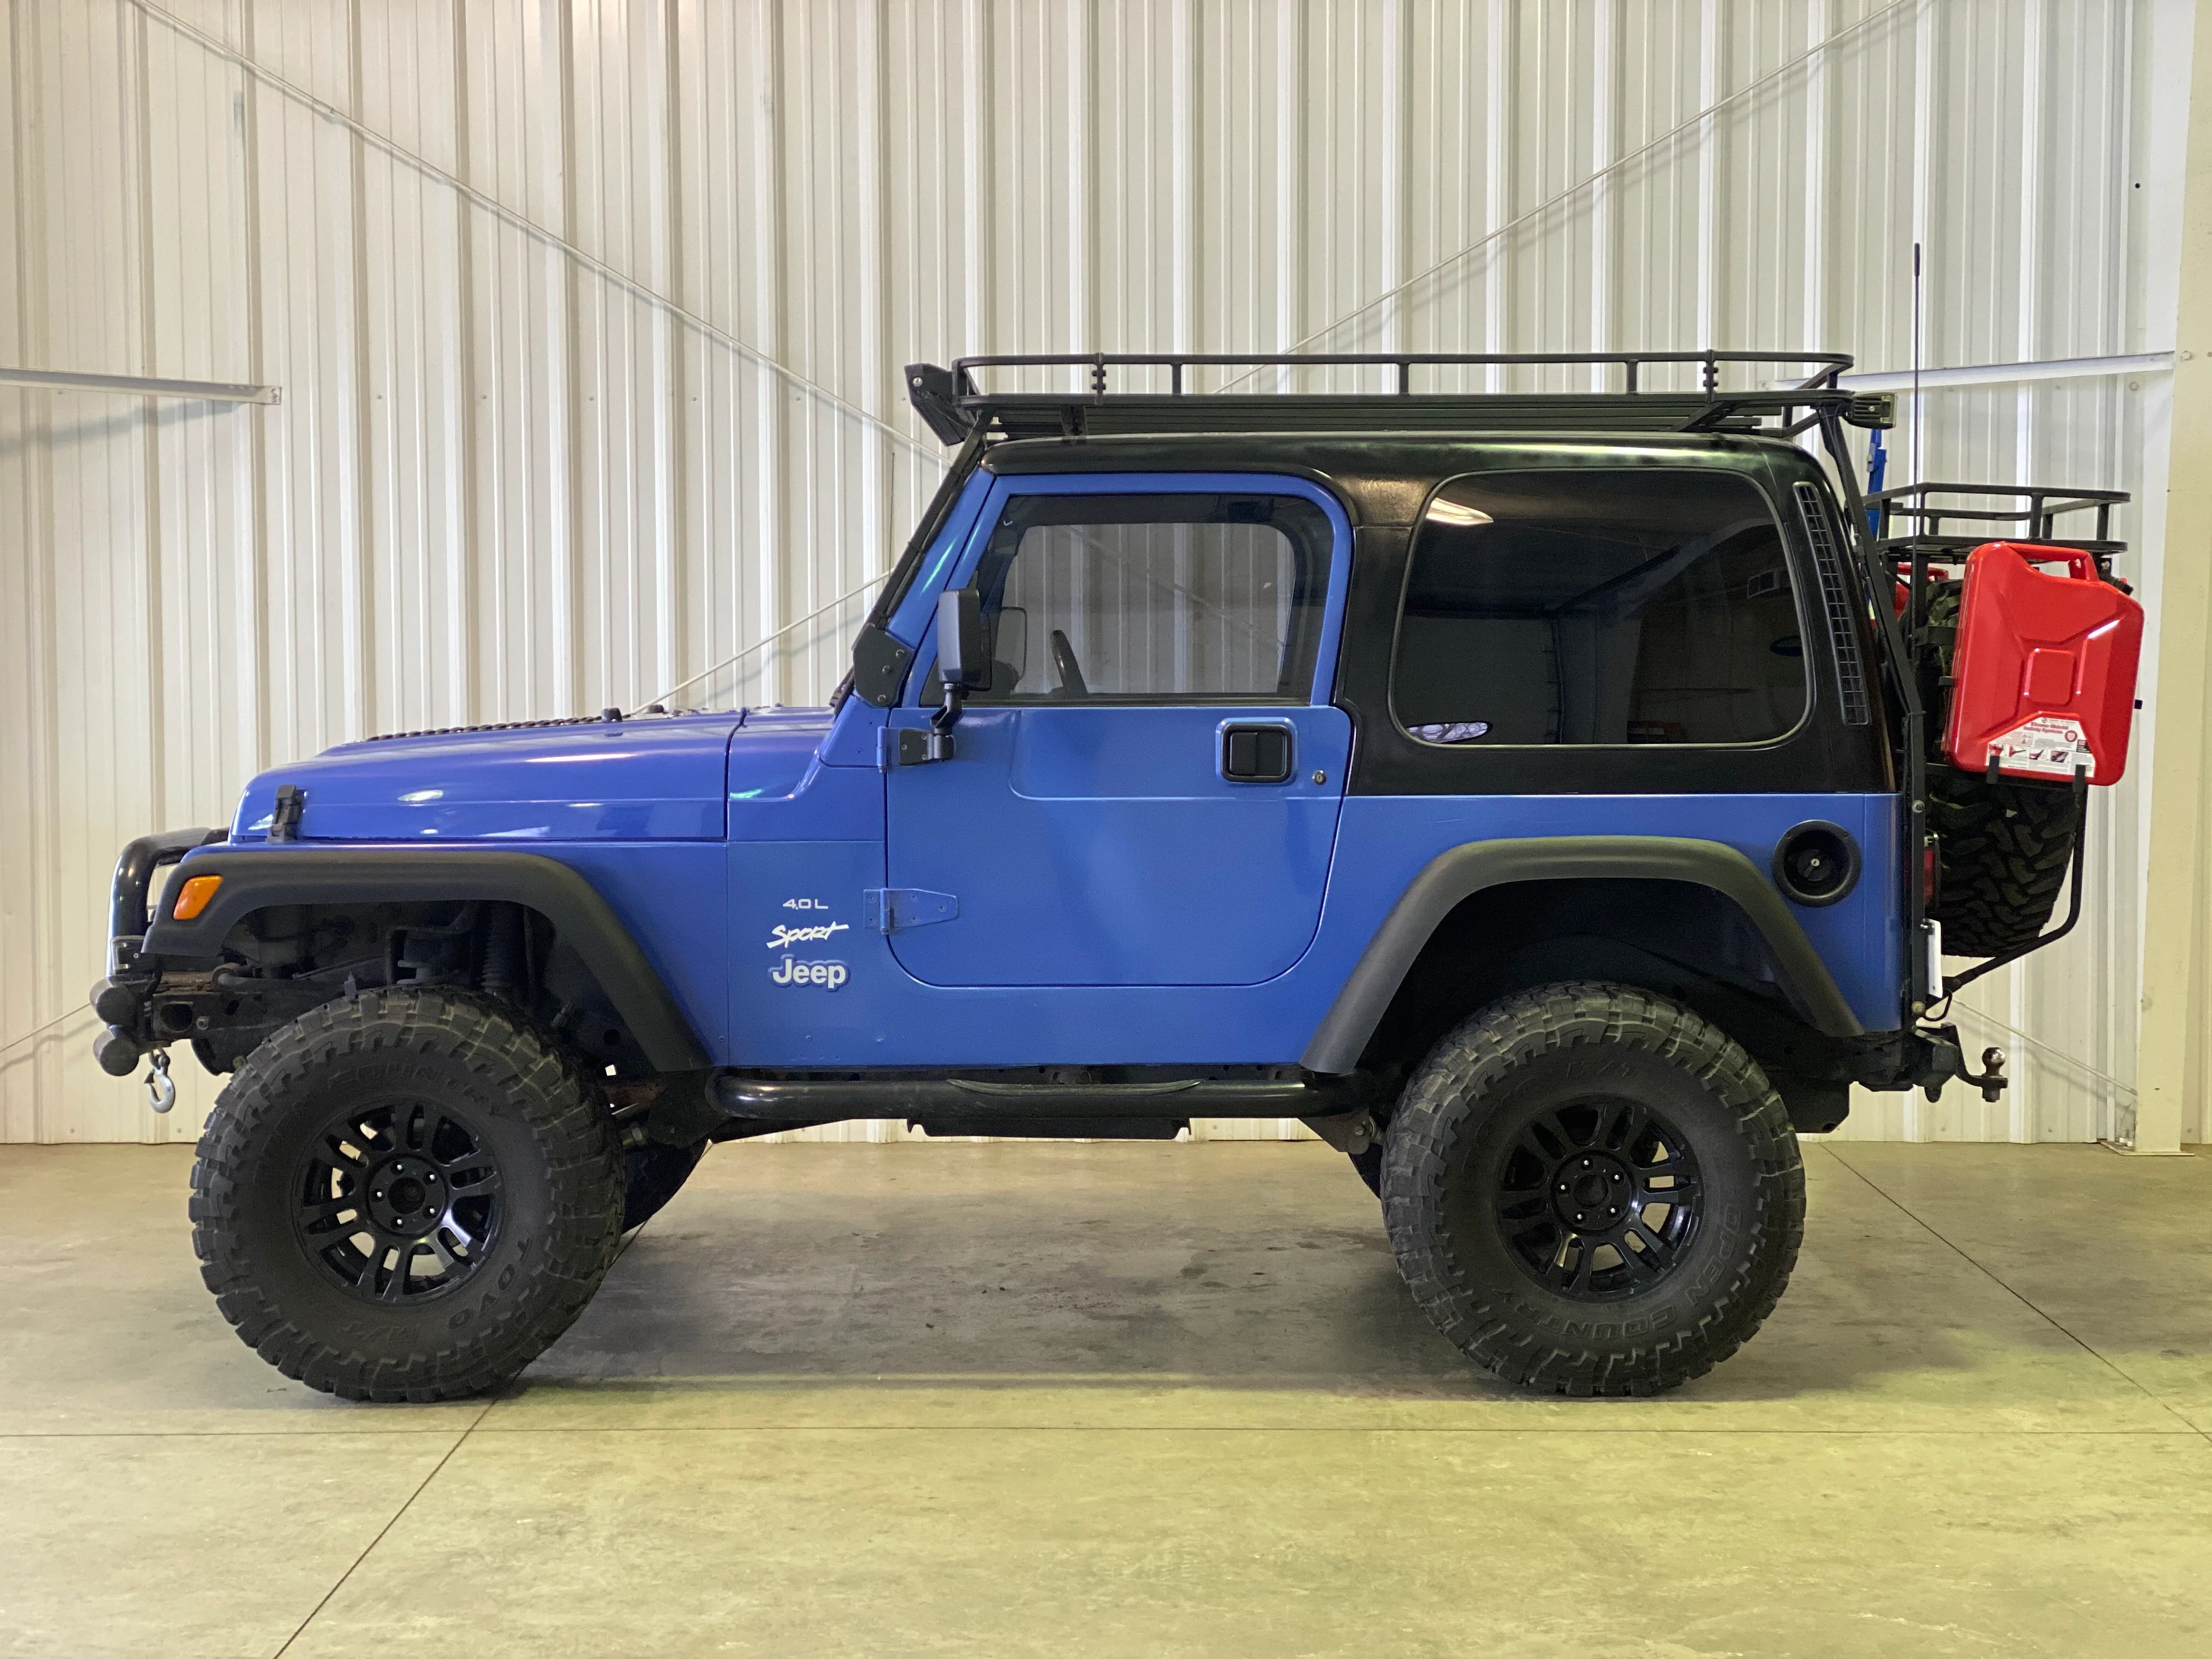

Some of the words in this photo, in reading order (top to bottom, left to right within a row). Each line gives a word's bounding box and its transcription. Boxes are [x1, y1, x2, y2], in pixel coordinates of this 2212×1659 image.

[766, 921, 849, 949] Sport
[772, 958, 846, 989] Jeep
[1685, 1204, 1743, 1307] OPEN
